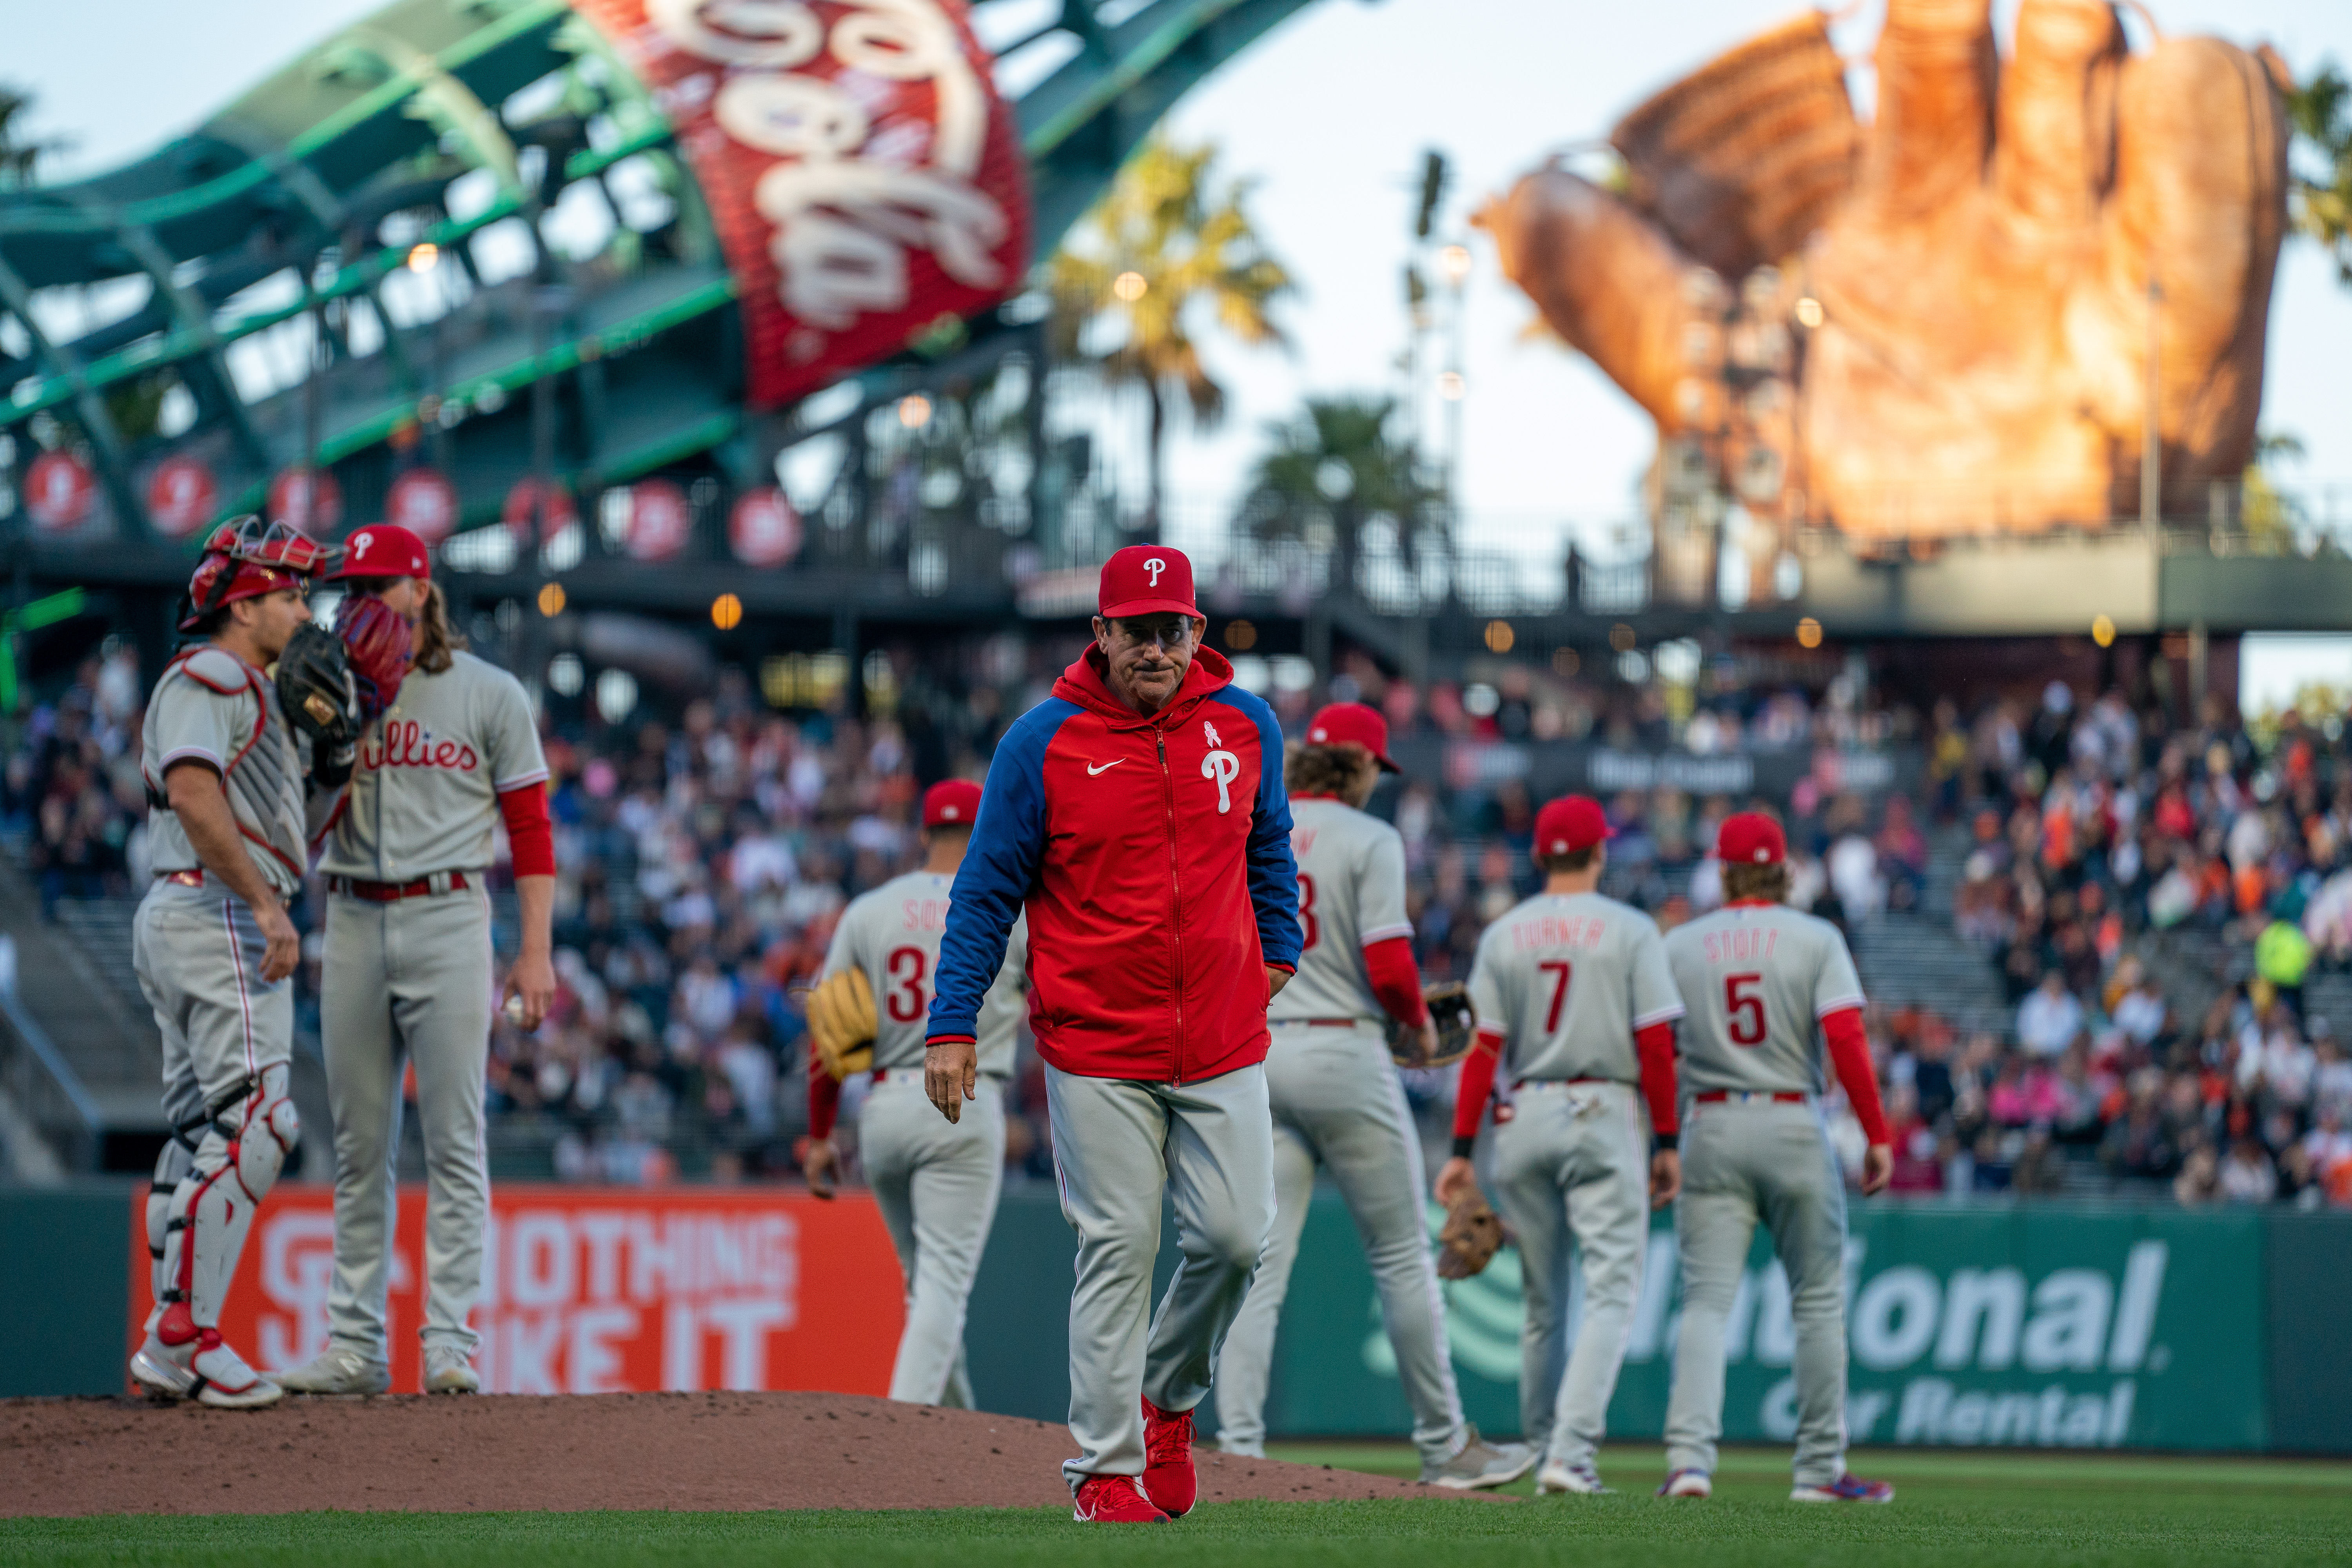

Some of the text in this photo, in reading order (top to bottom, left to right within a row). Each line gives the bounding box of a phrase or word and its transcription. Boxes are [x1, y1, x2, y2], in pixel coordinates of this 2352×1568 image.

[354, 532, 374, 561] P
[1143, 558, 1166, 588] P
[1201, 750, 1240, 815] P
[887, 944, 940, 1025] 3
[1537, 959, 1572, 1034] 7
[1724, 972, 1767, 1046] 5
[476, 1299, 797, 1394] IKE IT
[1896, 1377, 2136, 1447] Rental
